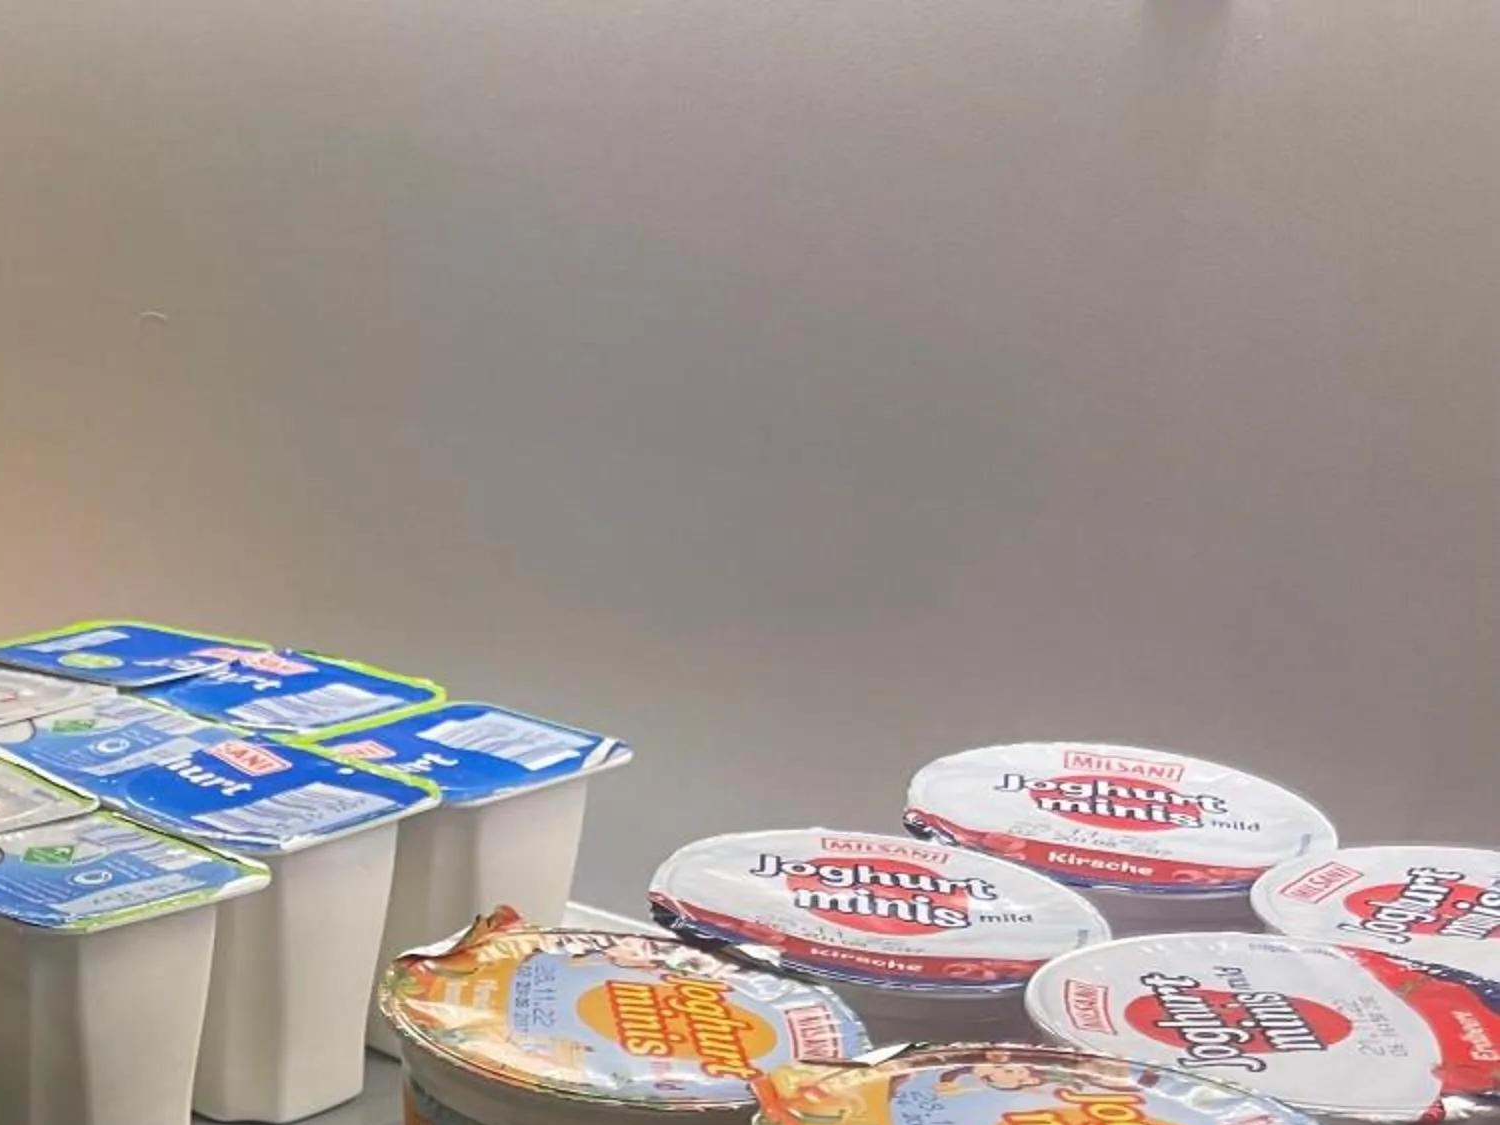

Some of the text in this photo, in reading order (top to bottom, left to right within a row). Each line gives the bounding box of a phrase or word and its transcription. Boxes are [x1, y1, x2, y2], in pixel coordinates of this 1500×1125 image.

[150, 752, 253, 797] hurt
[1071, 754, 1177, 781] MILSANI
[993, 773, 1229, 814] Joghurt
[1037, 797, 1261, 832] minis mild
[750, 853, 998, 901] Joghurt
[1047, 851, 1155, 877] Kirsche
[794, 888, 1033, 929] minis mild
[605, 979, 686, 1058] minis
[660, 972, 765, 1080] Joghurt
[1140, 972, 1267, 1073] Joghurt
[1220, 990, 1329, 1052] minis
